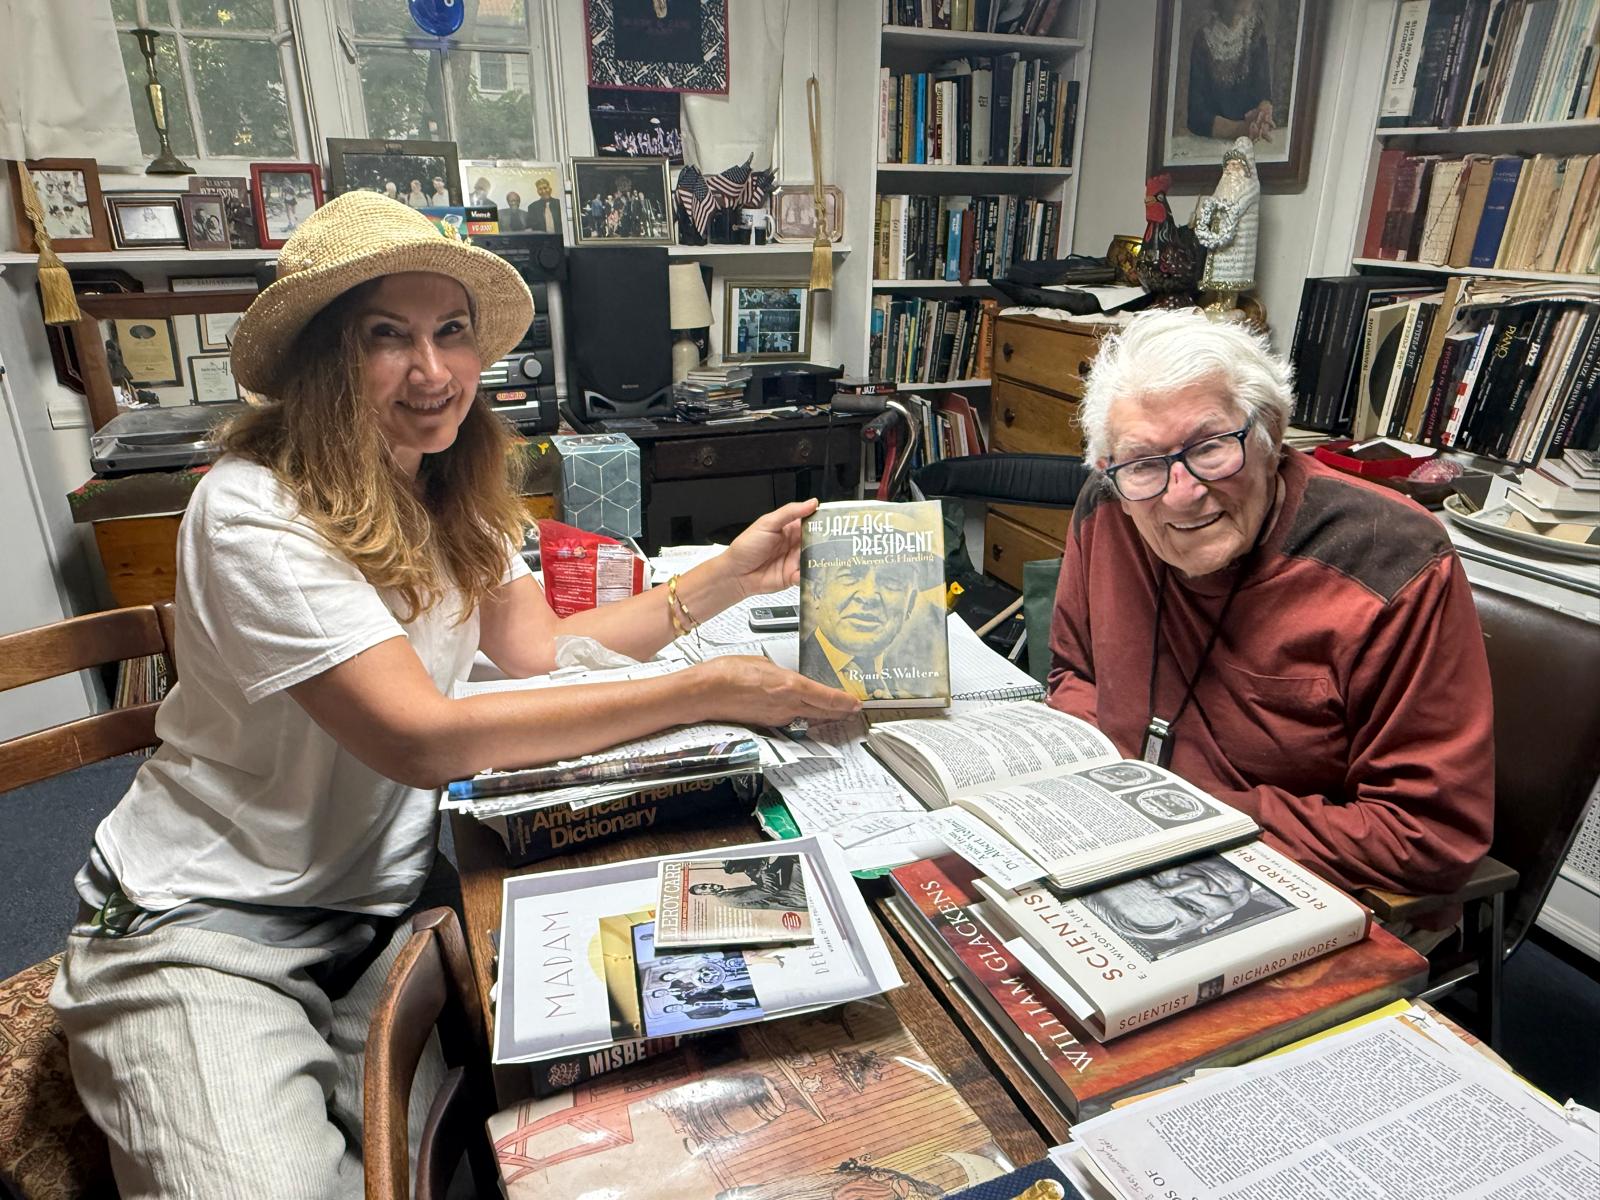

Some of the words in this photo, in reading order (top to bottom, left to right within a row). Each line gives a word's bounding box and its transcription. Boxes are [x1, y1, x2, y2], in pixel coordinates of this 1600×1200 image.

[1399, 21, 1410, 52] RECORDS
[1409, 20, 1417, 41] BLUES
[1399, 58, 1409, 85] GOSPEL
[1038, 71, 1047, 102] BLUES
[1496, 325, 1516, 359] PIANO
[1524, 343, 1540, 367] JAZZ
[1580, 361, 1590, 377] JAZZ
[1586, 367, 1599, 389] Time
[861, 385, 876, 395] JAZZ
[1553, 413, 1570, 444] LEONARD
[808, 520, 823, 532] THE
[823, 515, 858, 537] JAZZ
[861, 512, 894, 534] AGE
[852, 530, 934, 556] PRESIDENT
[808, 559, 852, 569] Defending
[853, 557, 884, 568] Warren
[885, 555, 896, 564] G.
[897, 554, 934, 564] Harding
[849, 669, 879, 682] Ryan
[881, 668, 892, 680] S.
[893, 666, 940, 679] Walters
[532, 791, 640, 832] American
[640, 775, 726, 803] Heritage
[550, 807, 657, 849] Dictionary
[948, 830, 966, 846] from
[974, 837, 1004, 861] Albert
[1002, 857, 1019, 872] Dr.
[1272, 860, 1281, 868] THE
[665, 863, 681, 893] CARR
[1258, 861, 1326, 913] RICHARD
[1294, 874, 1316, 891] WINNER
[661, 897, 679, 938] LEROY
[920, 879, 1010, 973] GLACKENS
[1013, 886, 1125, 984] SCIENTIST
[543, 910, 576, 1019] MADAM
[1135, 970, 1148, 982] E.
[1119, 994, 1190, 1030] SCIENTIST
[1231, 957, 1287, 987] RICHARD
[1290, 936, 1339, 969] RHODES
[1001, 977, 1094, 1075] WILLIAM
[1144, 1169, 1166, 1187] OF
